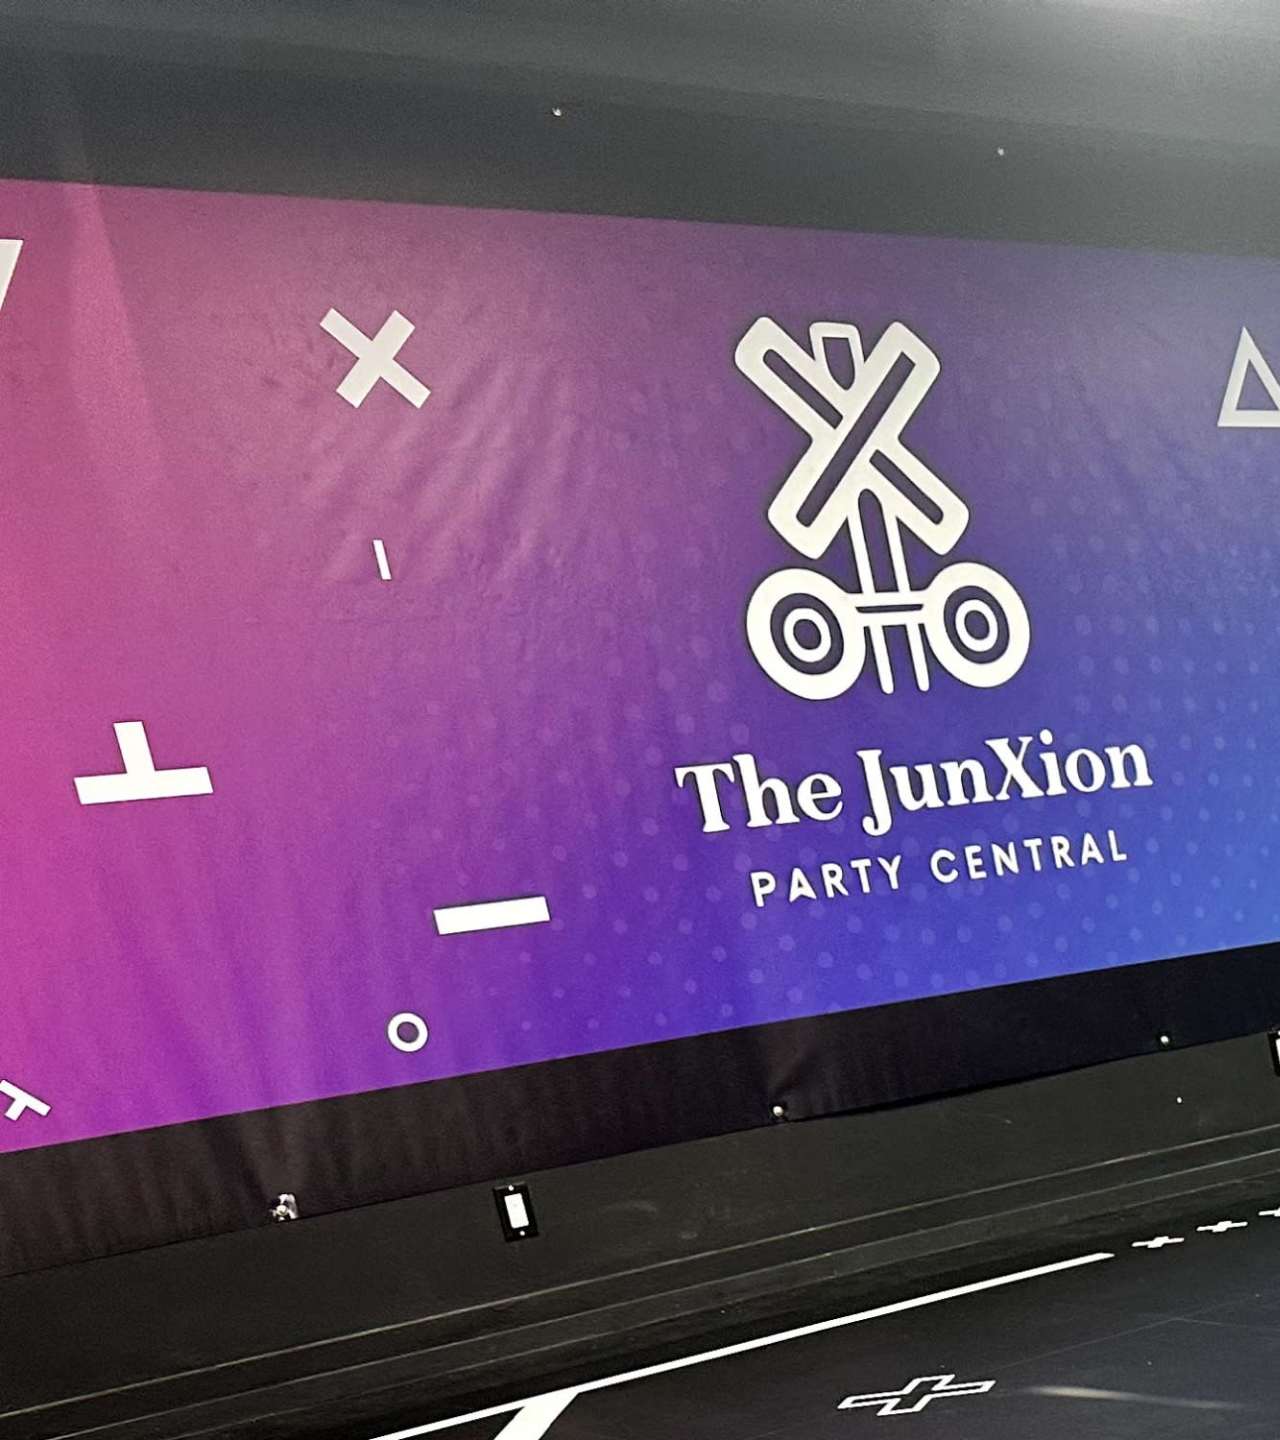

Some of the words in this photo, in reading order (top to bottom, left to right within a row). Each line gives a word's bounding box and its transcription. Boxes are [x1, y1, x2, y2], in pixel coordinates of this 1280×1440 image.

[674, 753, 844, 834] The
[856, 729, 1154, 837] JunXion
[750, 855, 902, 908] PARTY
[930, 829, 1128, 883] CENTRAL
